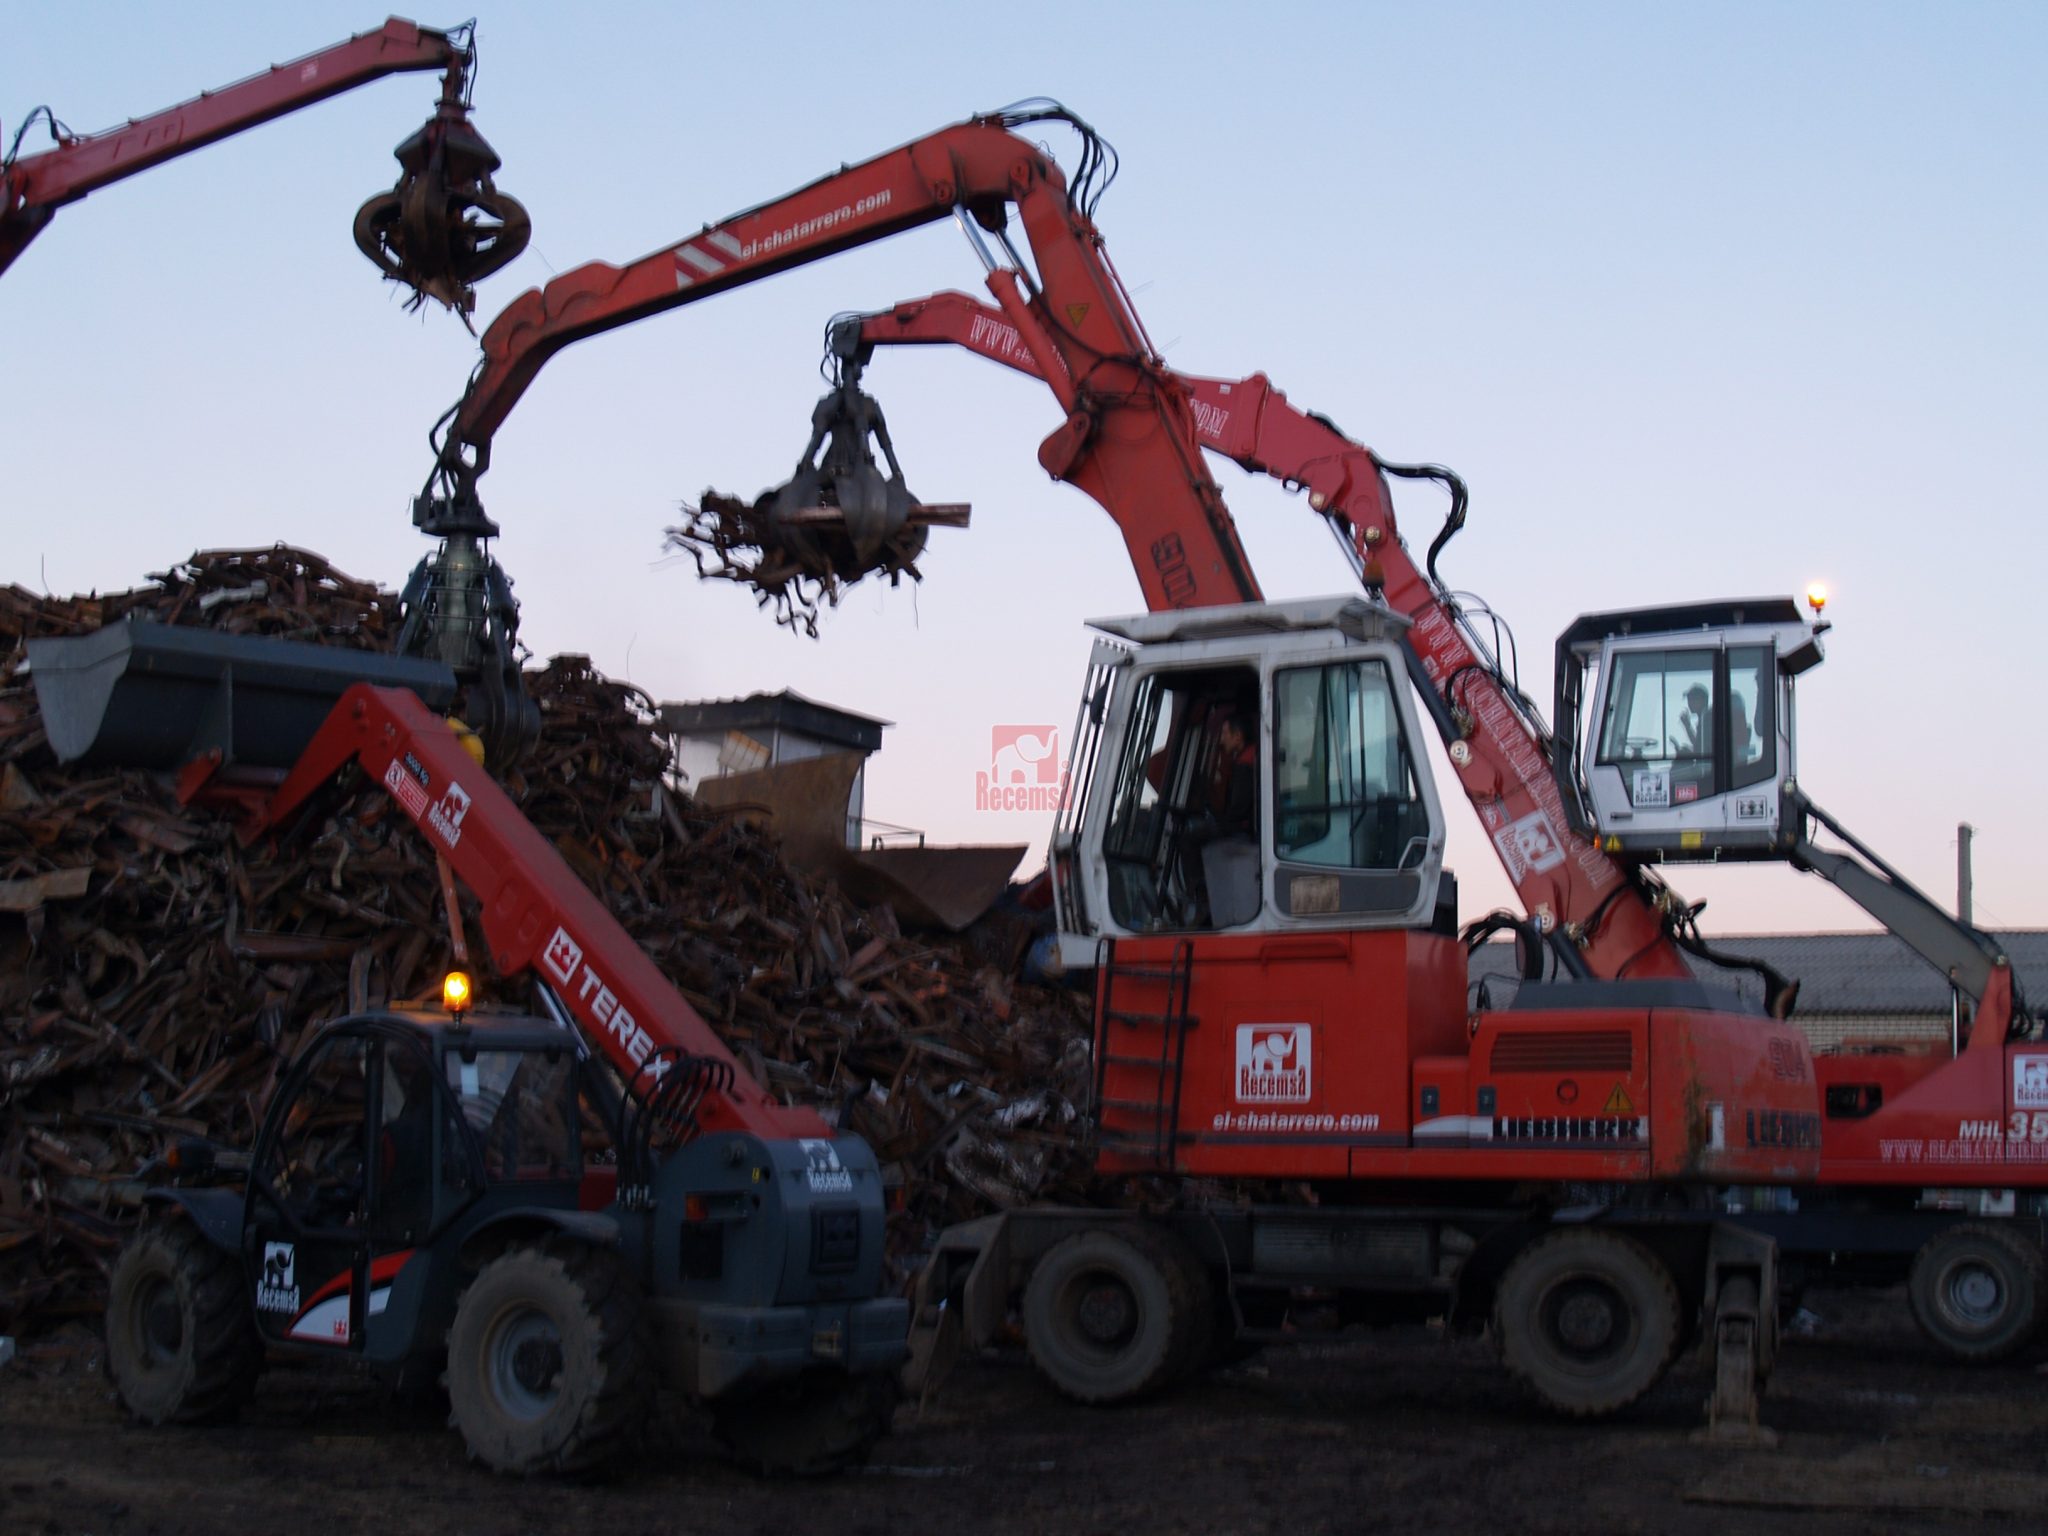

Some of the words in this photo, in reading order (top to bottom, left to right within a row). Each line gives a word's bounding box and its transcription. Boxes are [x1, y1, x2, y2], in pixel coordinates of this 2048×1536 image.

[742, 189, 891, 259] el-chatarrero.com
[579, 963, 672, 1093] TEREX
[1213, 1111, 1379, 1132] el-chatarrero.com
[1959, 1119, 2003, 1141] MHL
